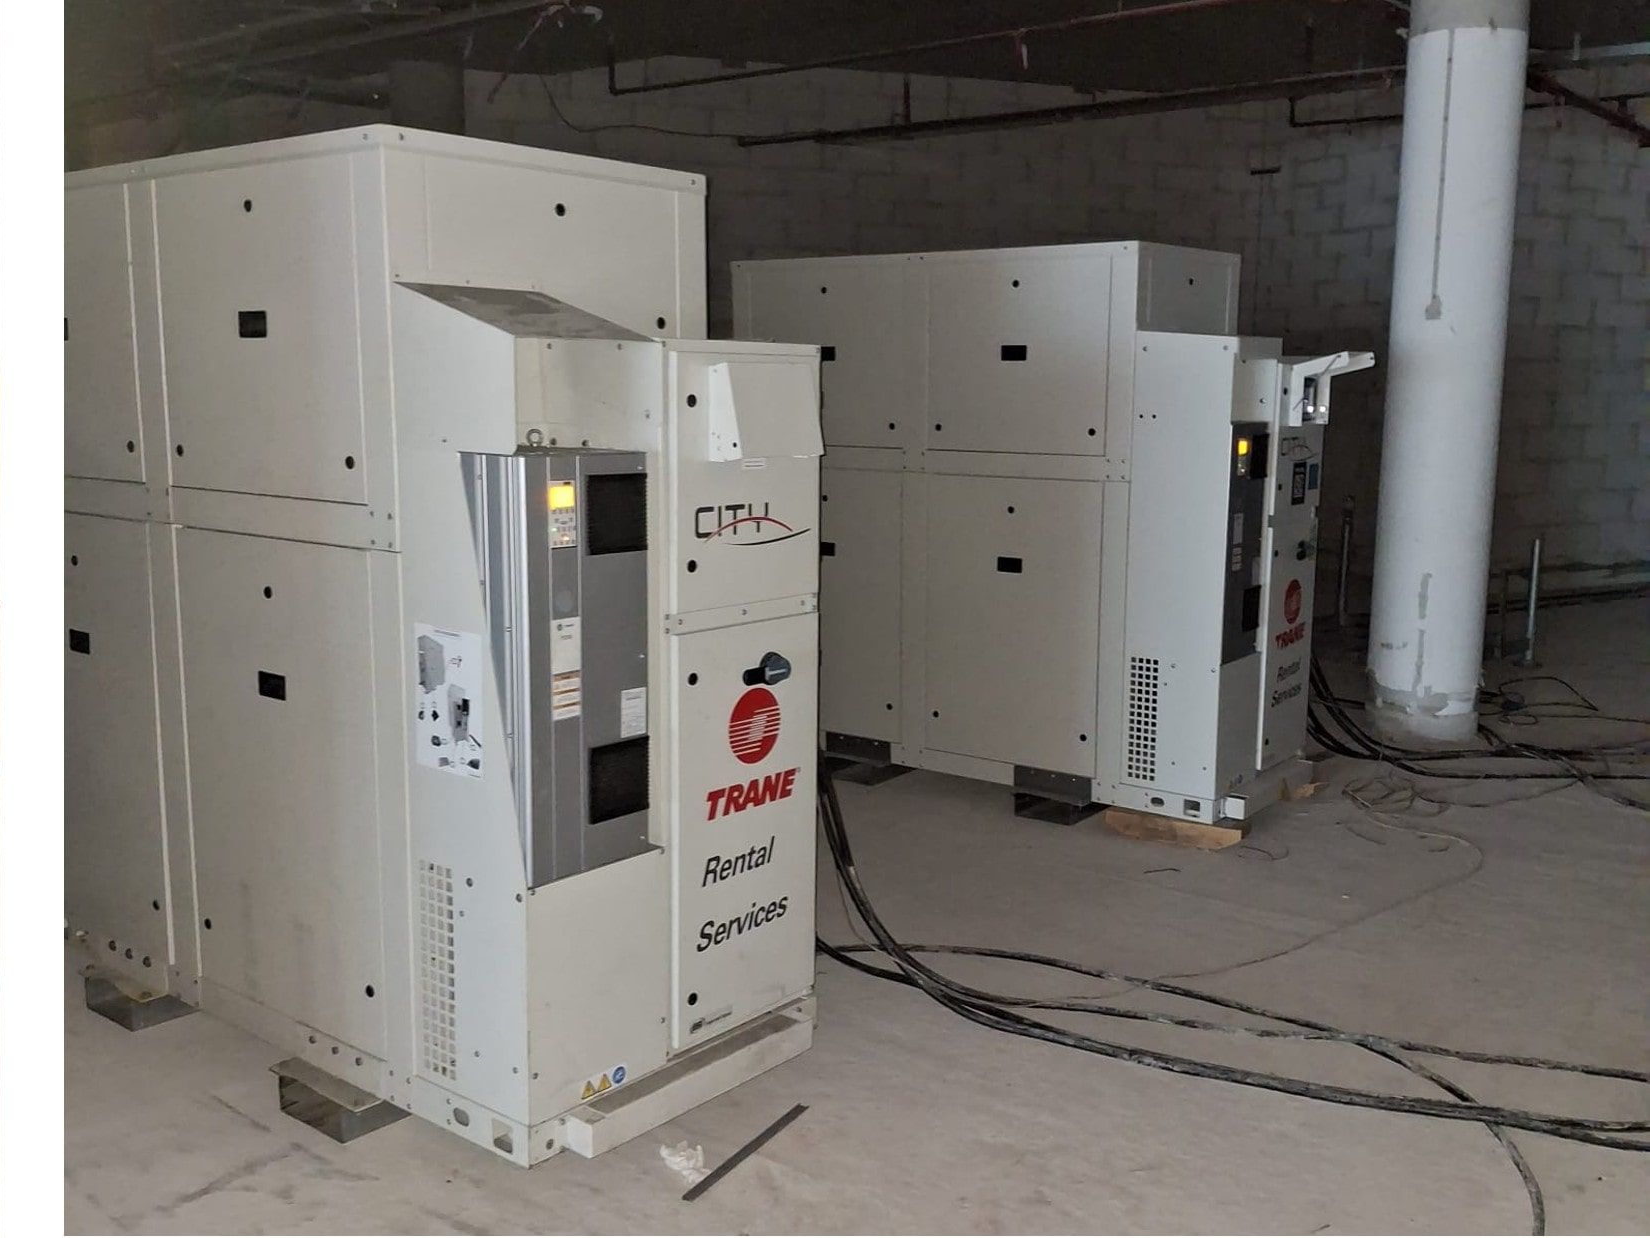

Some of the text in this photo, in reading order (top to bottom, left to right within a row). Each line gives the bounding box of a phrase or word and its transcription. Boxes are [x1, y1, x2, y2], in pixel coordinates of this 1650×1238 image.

[695, 502, 770, 539] CITY
[1275, 621, 1306, 650] TRANE
[706, 767, 798, 822] TRANE
[702, 835, 776, 888] Rental
[696, 895, 789, 953] Services
